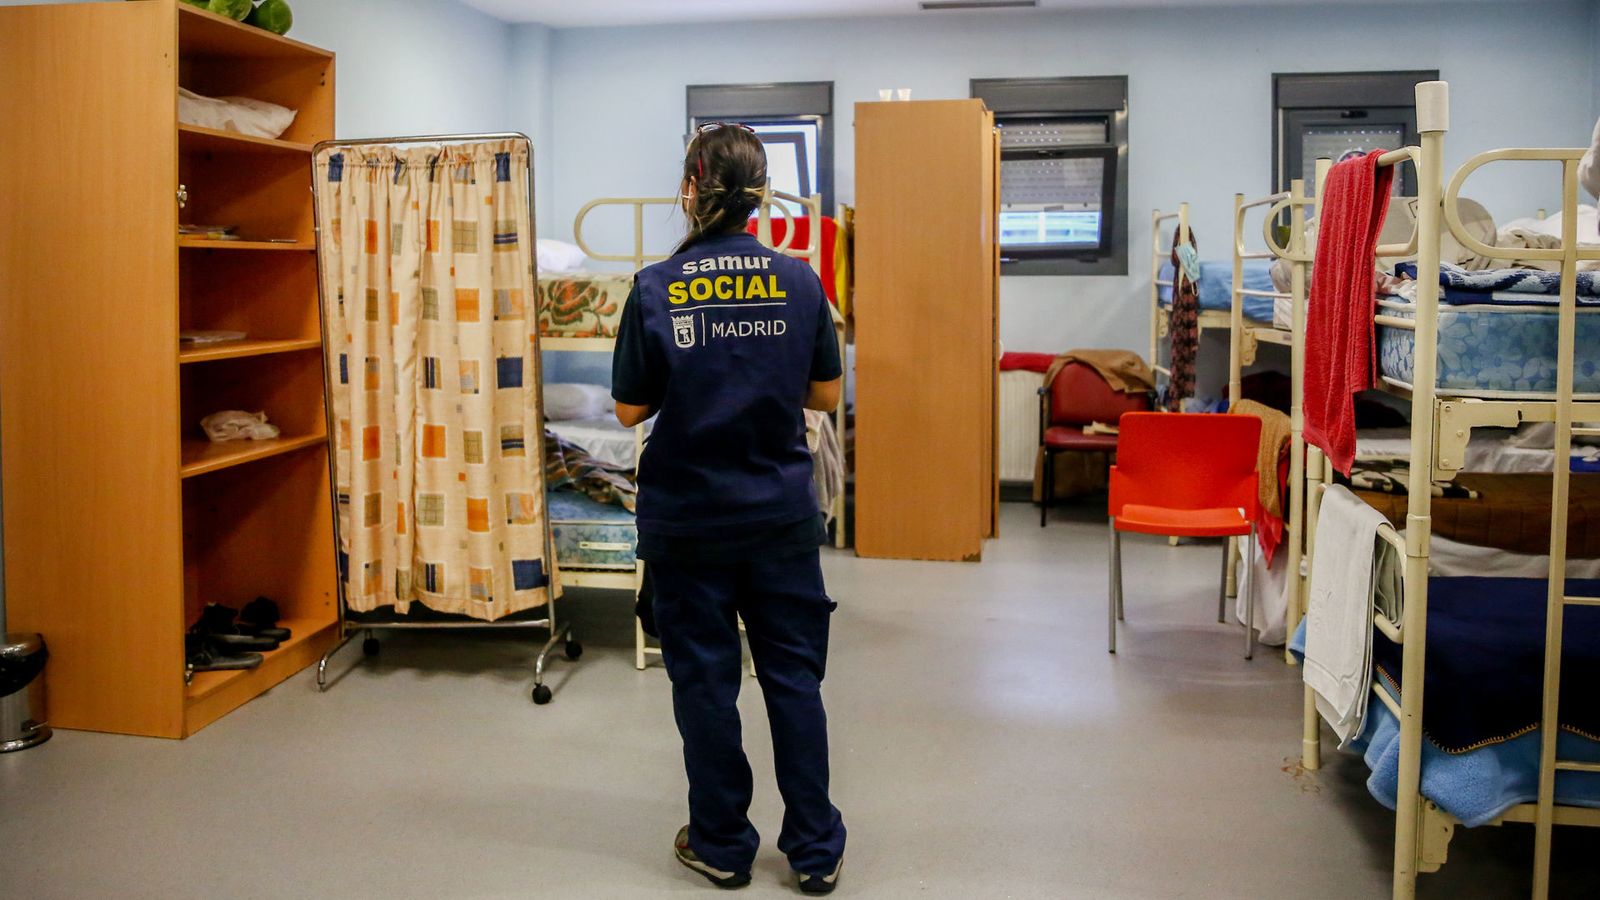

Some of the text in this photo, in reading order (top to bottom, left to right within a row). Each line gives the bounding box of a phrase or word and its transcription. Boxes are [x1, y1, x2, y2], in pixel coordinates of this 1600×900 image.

[682, 255, 772, 275] samur
[668, 274, 787, 304] SOCIAL
[712, 320, 787, 338] MADRID
